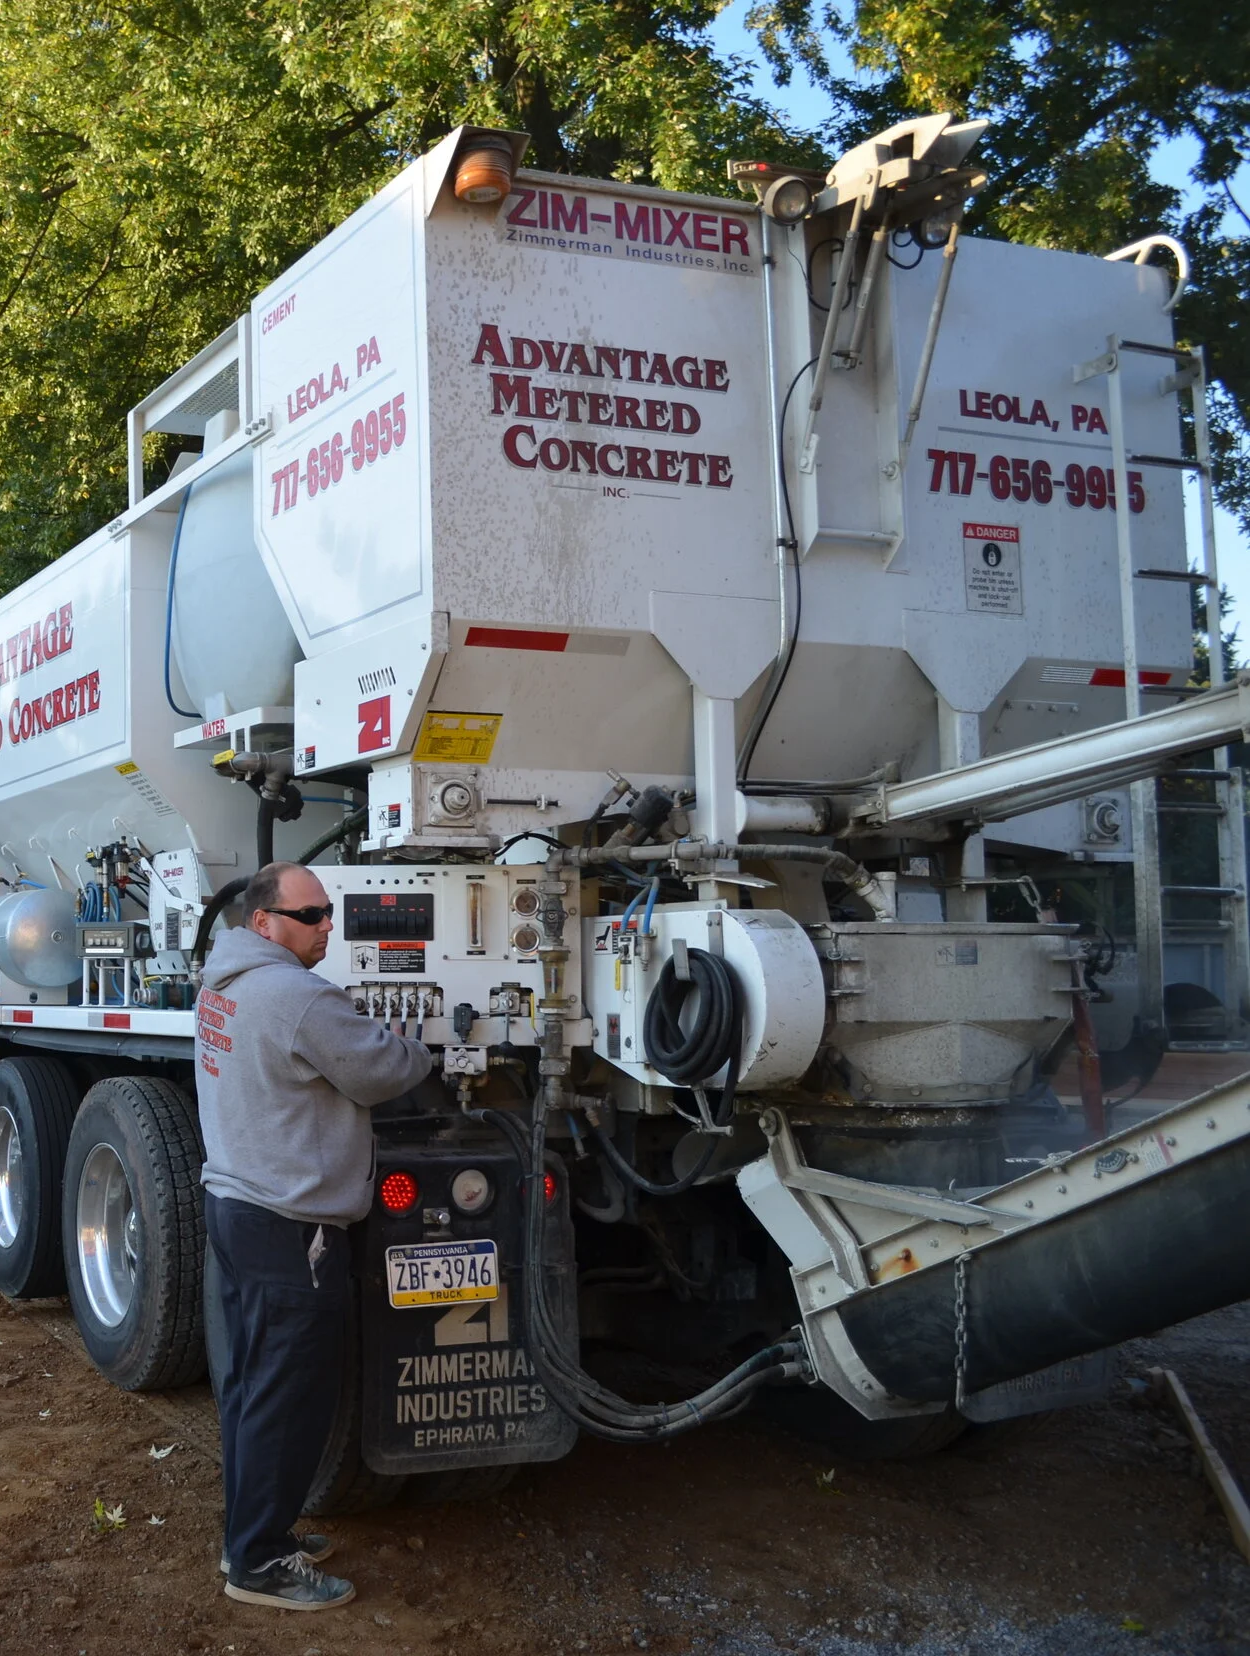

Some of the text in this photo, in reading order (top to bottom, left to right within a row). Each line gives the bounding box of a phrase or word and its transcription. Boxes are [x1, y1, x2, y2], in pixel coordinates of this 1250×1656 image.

[506, 188, 750, 256] ZIM-MIXER
[506, 229, 612, 254] Zimmerman
[262, 294, 296, 335] CEMENT
[287, 336, 381, 424] LEOLA, PA
[471, 324, 730, 393] ADVANTAGE
[489, 373, 701, 435] METERED
[959, 389, 1109, 435] LEOLA, PA
[271, 392, 406, 517] 717-656-9955
[503, 424, 734, 489] CONCRETE
[602, 486, 631, 500] INC.
[976, 526, 1016, 539] DANGER
[9, 670, 101, 747] CONCRETE
[202, 719, 225, 739] WATER
[414, 1247, 468, 1257] PENNSYLVANIA
[430, 1291, 462, 1300] TRUCK
[397, 1384, 547, 1424] INDUSTRIES
